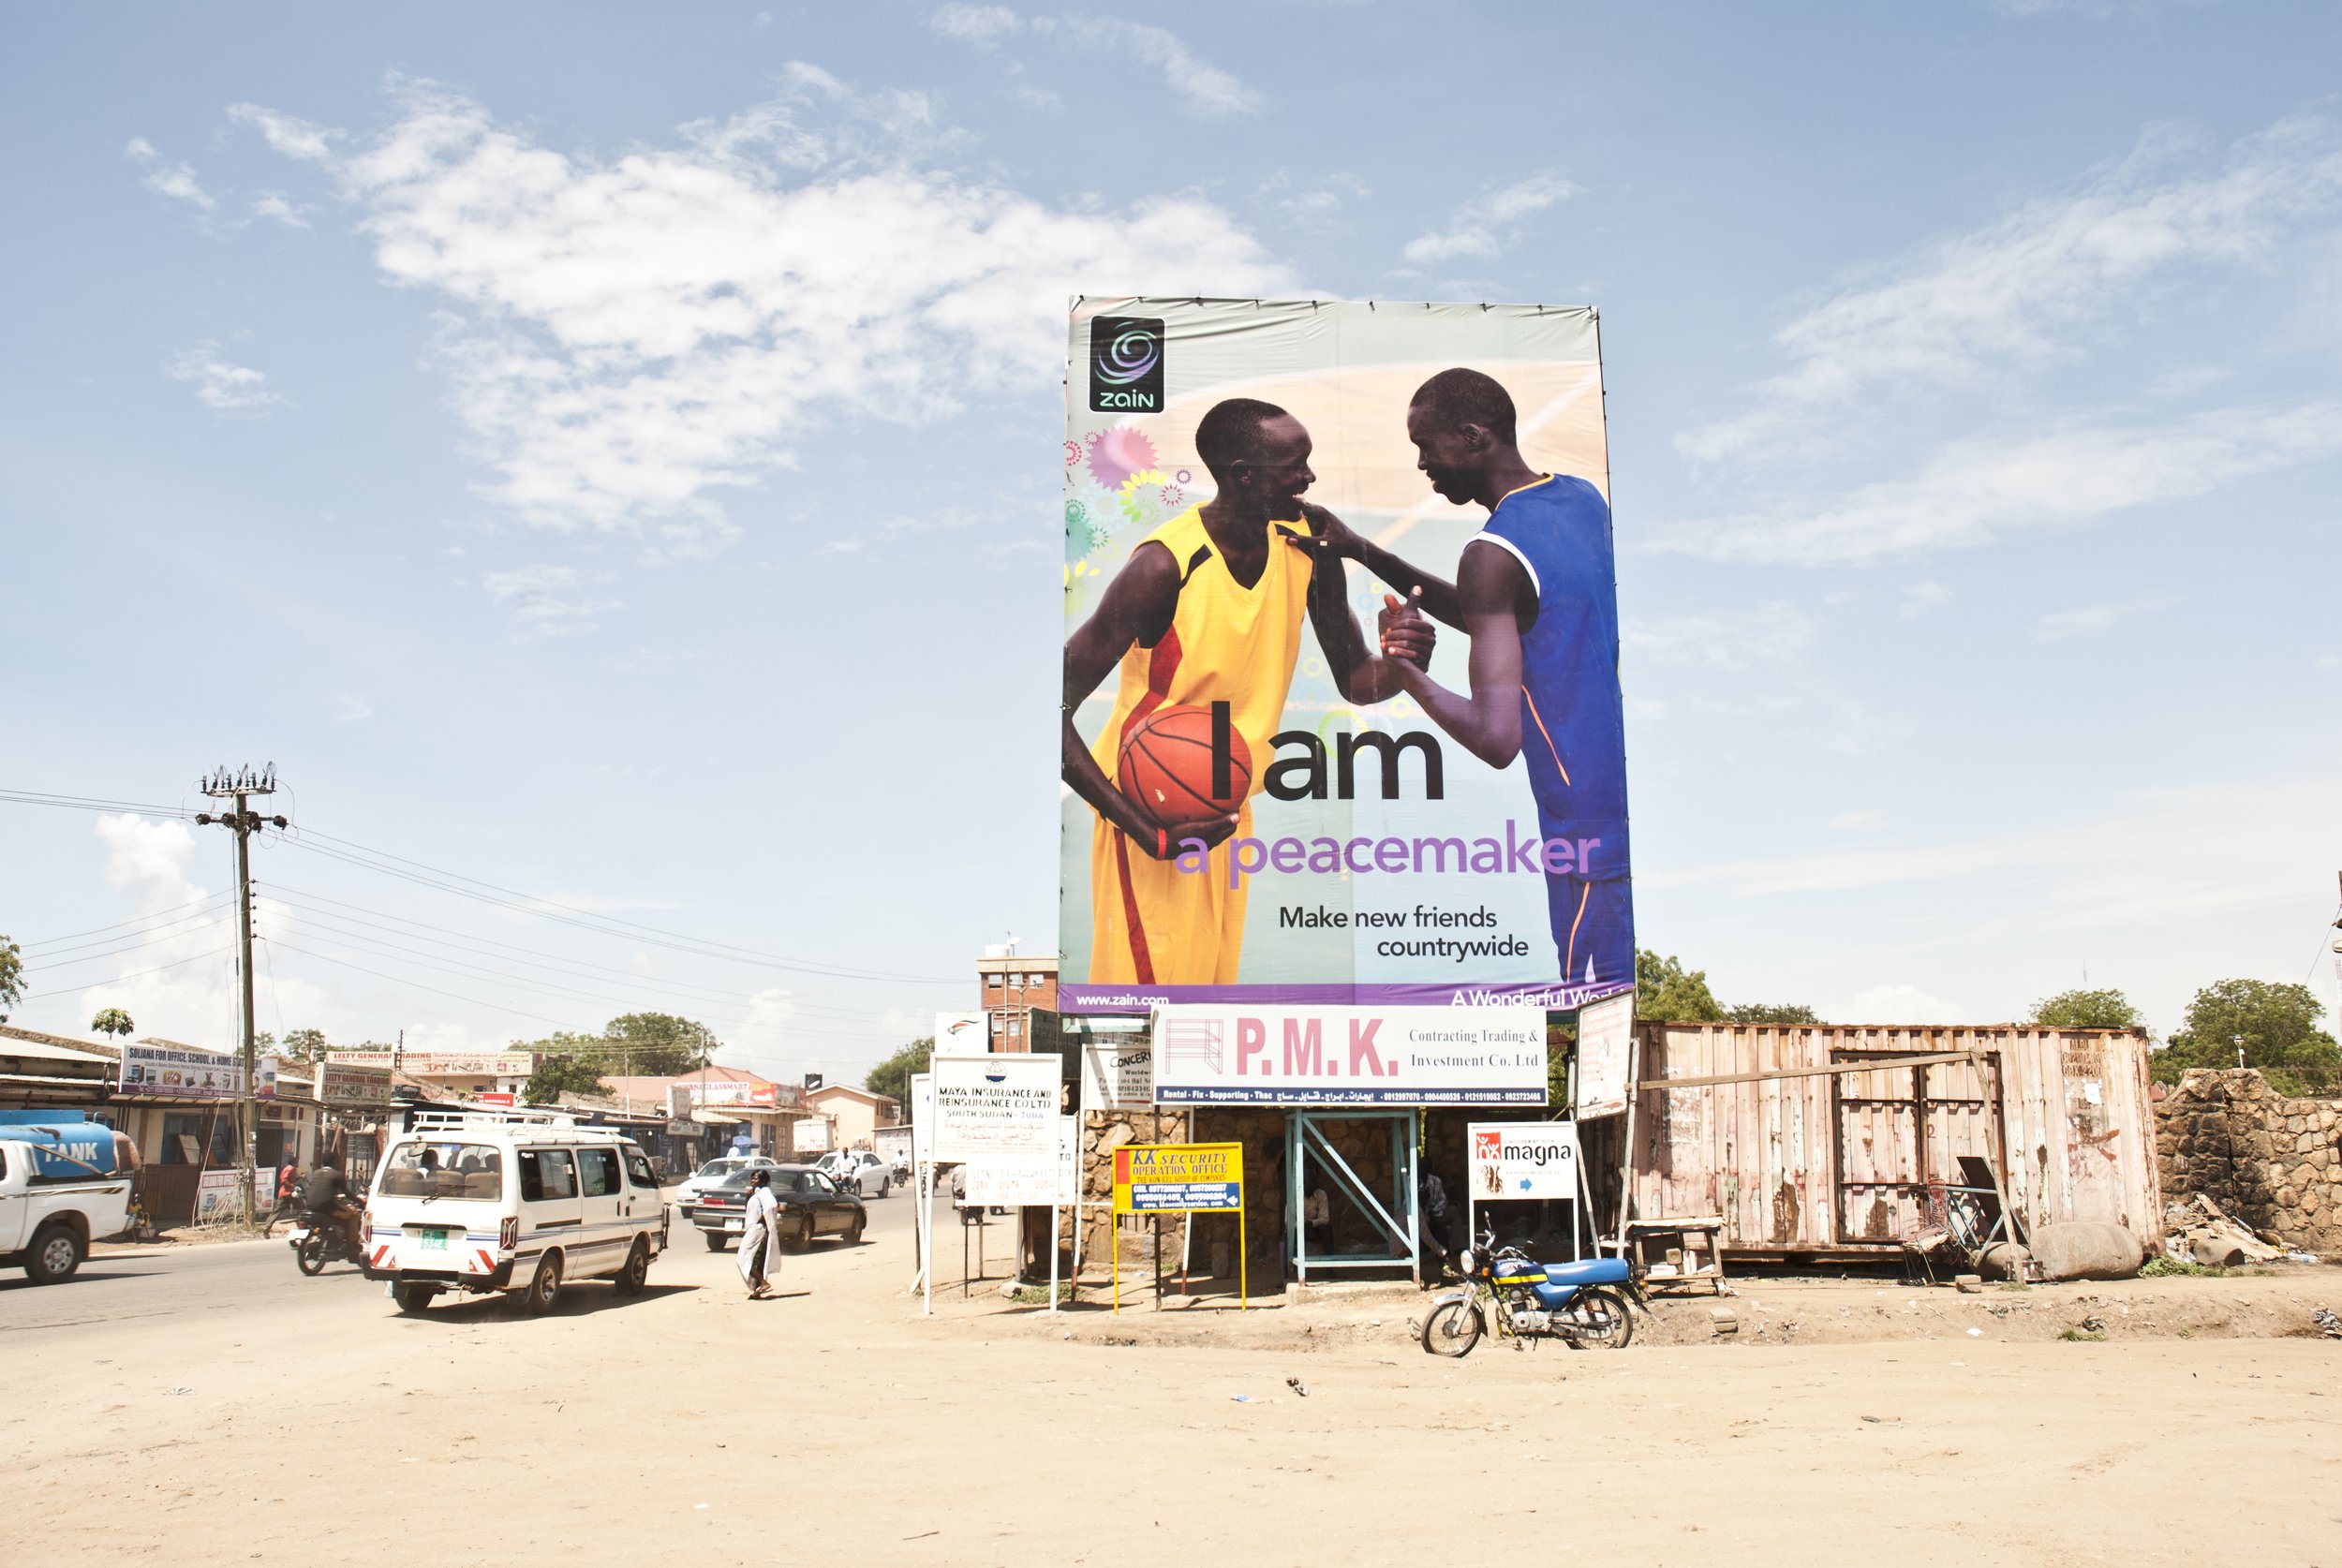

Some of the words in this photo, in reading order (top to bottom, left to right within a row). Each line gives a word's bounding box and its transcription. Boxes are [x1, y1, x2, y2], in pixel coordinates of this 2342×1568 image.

[1100, 389, 1154, 407] zain
[1211, 701, 1232, 800] I
[1263, 730, 1445, 801] am
[1175, 836, 1208, 874] a
[1229, 819, 1602, 890] peacemaker
[1280, 905, 1348, 927] Make
[1355, 912, 1407, 927] new
[1414, 905, 1497, 927] friends
[1377, 934, 1529, 963] countrywide
[1076, 993, 1169, 1006] www.zain.com
[1451, 989, 1467, 1006] A
[1469, 989, 1565, 1006] Wonderful
[1409, 1029, 1477, 1044] Contracting
[1482, 1029, 1525, 1044] Trading
[1529, 1029, 1538, 1042] &
[1237, 1017, 1398, 1076] P.M.K.
[129, 1048, 154, 1059] SOLIANA
[156, 1050, 167, 1060] FOR
[216, 1056, 231, 1066] HOME
[1412, 1054, 1484, 1067] Investment
[1489, 1054, 1511, 1067] Co.
[1516, 1054, 1538, 1067] Ltd
[940, 1087, 967, 1096] MAYA
[972, 1088, 1030, 1098] INSURANCE
[1033, 1089, 1051, 1099] AND
[1164, 1089, 1187, 1099] Rental
[1193, 1089, 1204, 1099] Fix
[1209, 1089, 1249, 1102] Supporting
[939, 1098, 1010, 1107] REINSURANCE
[42, 1142, 97, 1162] TANK
[1134, 1149, 1158, 1164] KK
[1162, 1153, 1229, 1164] SECURITY
[1505, 1146, 1571, 1166] magna
[1133, 1165, 1186, 1176] OPERATION
[1192, 1163, 1228, 1174] OFFICE
